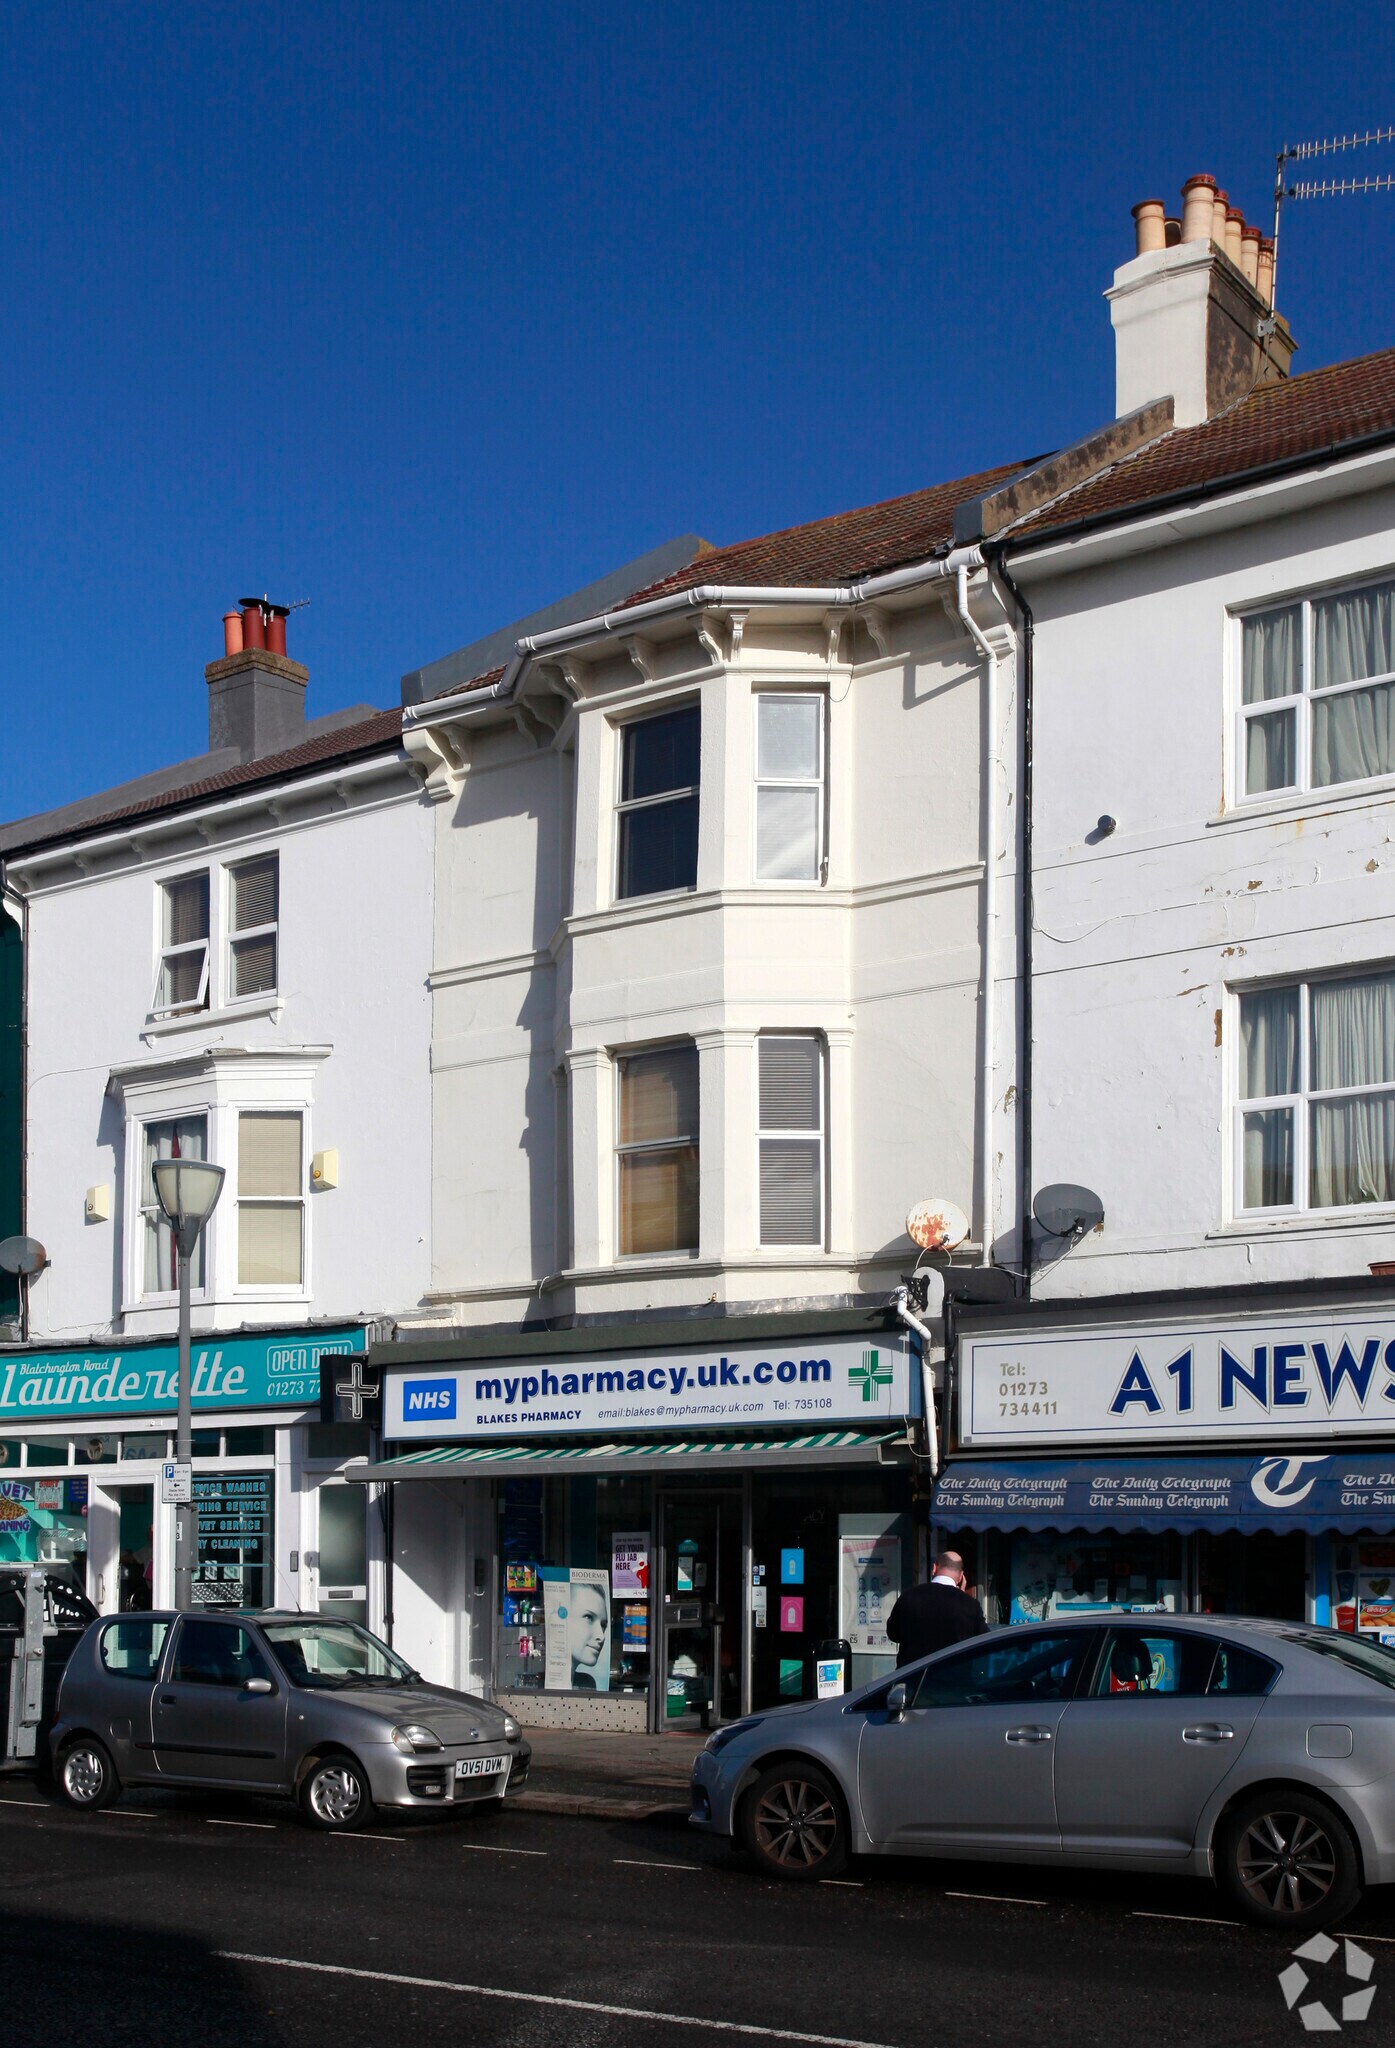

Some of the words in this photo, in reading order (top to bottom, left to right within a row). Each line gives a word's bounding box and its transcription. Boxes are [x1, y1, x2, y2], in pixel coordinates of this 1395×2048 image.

[20, 1361, 80, 1376] Blatchington
[83, 1358, 109, 1371] Road
[272, 1348, 307, 1372] OPEN
[1000, 1362, 1026, 1376] Tel:
[475, 1357, 832, 1405] mypharmacy.uk.com
[1108, 1345, 1193, 1416] A1
[267, 1381, 304, 1396] 01273
[999, 1381, 1048, 1396] 01273
[408, 1390, 451, 1410] NHS
[476, 1413, 518, 1425] BLAKES
[521, 1410, 582, 1423] PHARMACY
[773, 1400, 791, 1410] Tel:
[794, 1398, 833, 1409] 735108
[999, 1401, 1057, 1417] 734411
[226, 1482, 266, 1492] WASHES
[939, 1478, 965, 1489] The
[966, 1477, 1001, 1491] Daily
[1003, 1477, 1068, 1491] Telegraph
[1092, 1477, 1120, 1489] The
[1121, 1476, 1159, 1491] Daily
[1161, 1476, 1231, 1491] Telegraph
[1343, 1474, 1375, 1487] The
[226, 1500, 267, 1512] SERVICE
[936, 1494, 959, 1506] The
[960, 1494, 1005, 1508] Sunday
[1007, 1494, 1064, 1508] Telegraph
[1089, 1493, 1114, 1507] The
[1116, 1493, 1163, 1509] Sunday
[1166, 1493, 1229, 1509] Telegraph
[1341, 1492, 1369, 1506] The
[220, 1520, 261, 1531] SERVICE
[211, 1538, 259, 1549] CLEANING
[616, 1544, 626, 1552] GET
[628, 1544, 644, 1552] YOUR
[616, 1553, 626, 1561] FLU
[628, 1553, 638, 1561] JAB
[616, 1562, 631, 1570] HERE
[571, 1571, 606, 1579] BIODERMA
[462, 1760, 483, 1775] OV51
